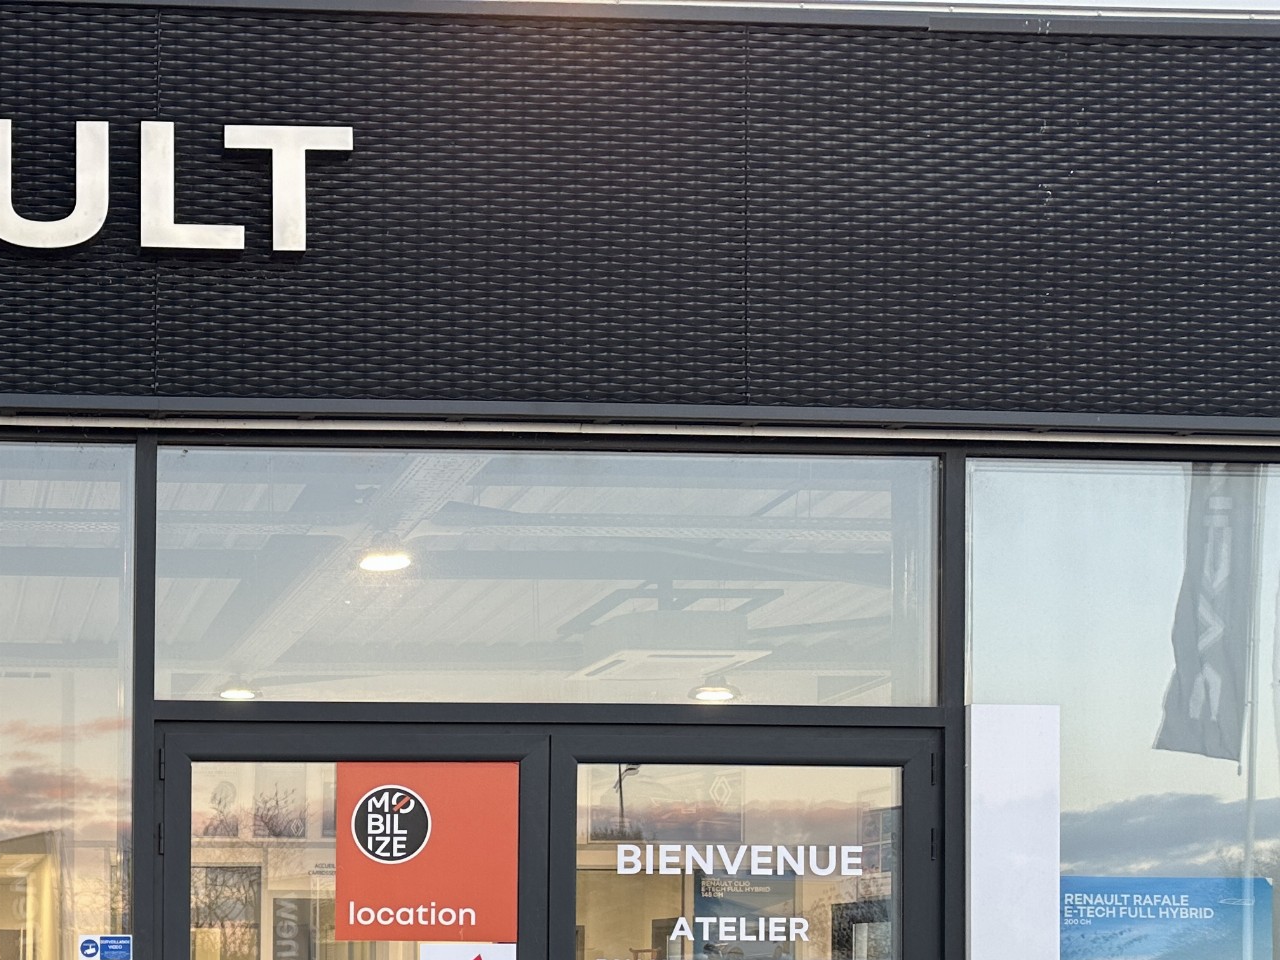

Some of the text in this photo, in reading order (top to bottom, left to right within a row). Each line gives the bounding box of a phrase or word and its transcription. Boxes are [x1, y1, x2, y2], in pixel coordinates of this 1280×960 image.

[368, 814, 407, 834] BIL
[368, 837, 407, 857] IZE
[617, 844, 863, 876] BIENVENUE
[1064, 893, 1189, 906] RENAULT RAFALE
[349, 901, 477, 925] location
[1064, 906, 1214, 919] E-TECH FULL HYBRID
[669, 916, 810, 942] ATELIER
